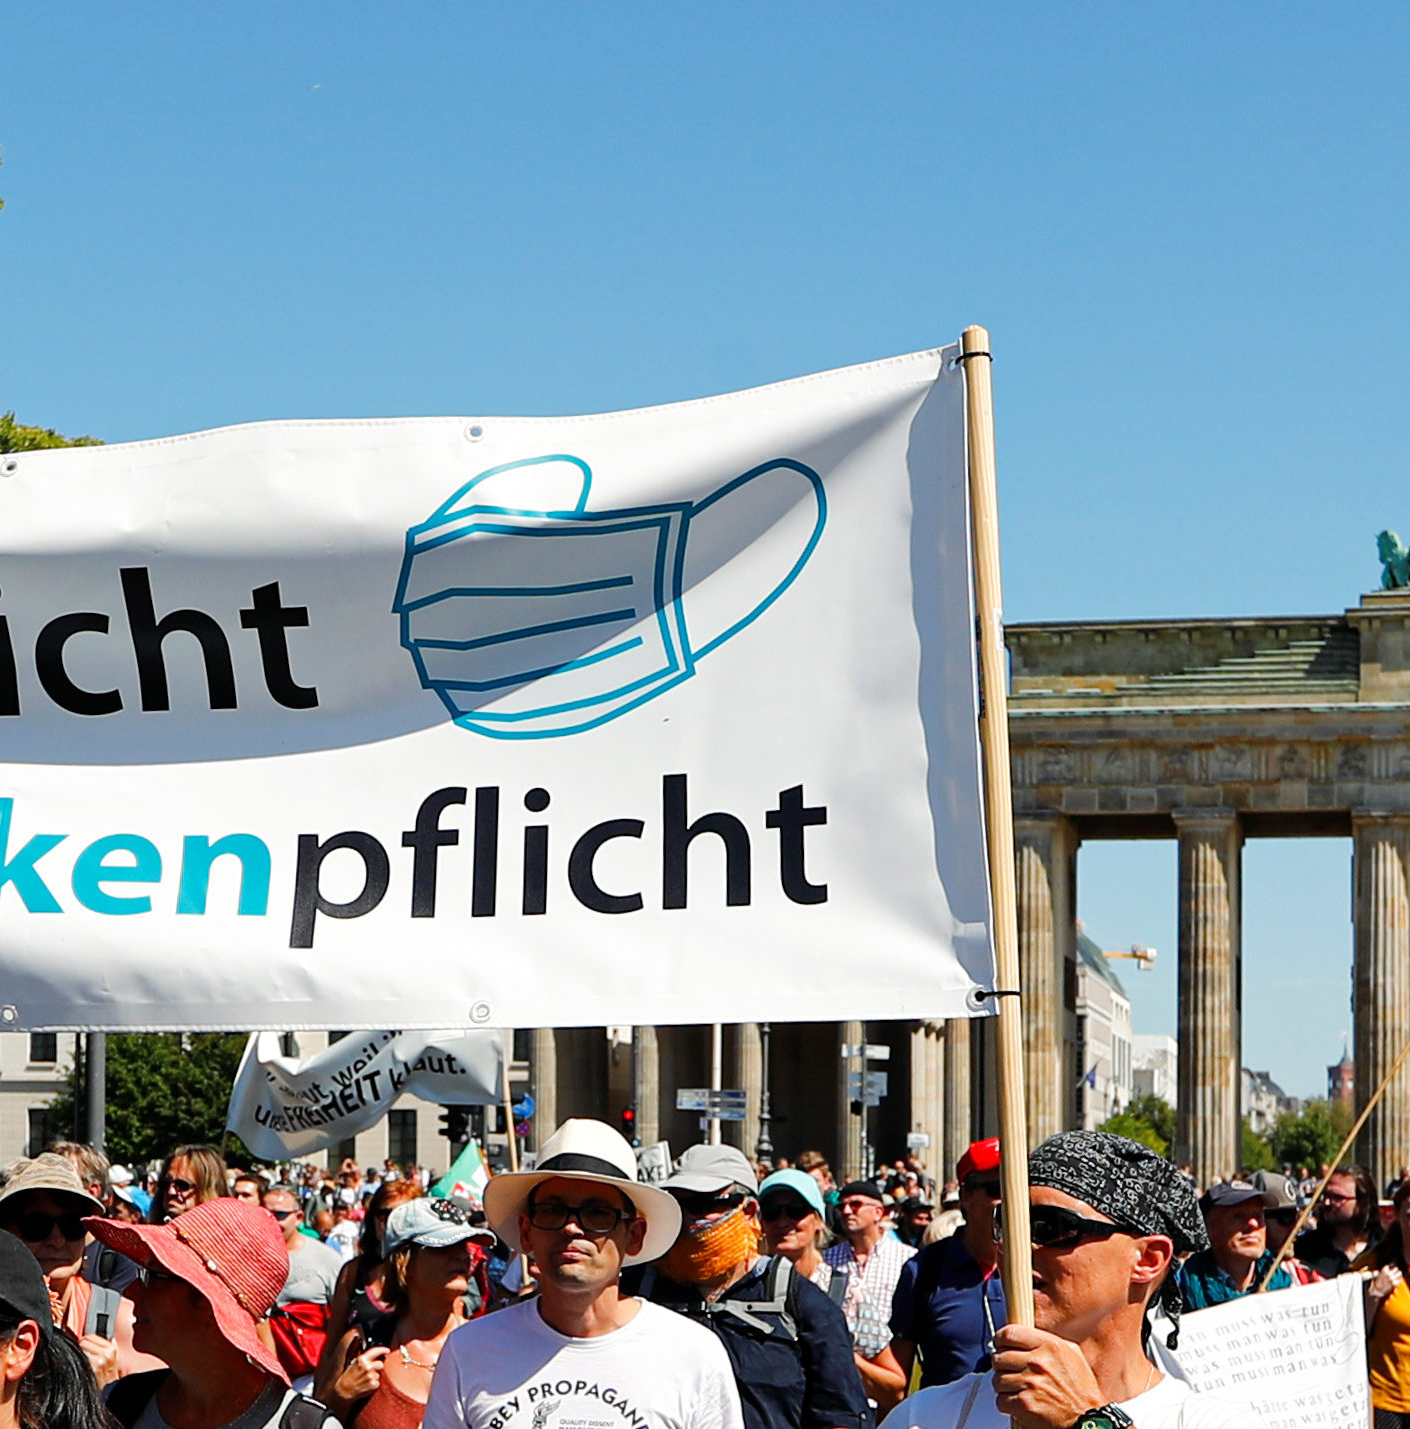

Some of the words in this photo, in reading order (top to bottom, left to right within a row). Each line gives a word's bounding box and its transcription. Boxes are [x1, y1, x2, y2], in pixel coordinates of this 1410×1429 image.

[283, 1070, 382, 1132] FREIHEIT
[637, 1164, 664, 1183] AKE
[1215, 1316, 1257, 1337] muss
[1260, 1308, 1293, 1325] was
[1301, 1302, 1331, 1318] tun
[1177, 1343, 1223, 1363] muss
[1226, 1332, 1262, 1351] man
[1265, 1326, 1298, 1342] was
[1303, 1317, 1333, 1334] tun
[1184, 1359, 1221, 1379] was
[1269, 1340, 1304, 1360] man
[1308, 1335, 1335, 1352] tun
[1191, 1376, 1226, 1395] tun
[1272, 1358, 1309, 1377] man
[1310, 1353, 1339, 1369] was
[1325, 1380, 1368, 1408] geta
[559, 1418, 588, 1426] QUALITY
[1328, 1399, 1368, 1425] geta
